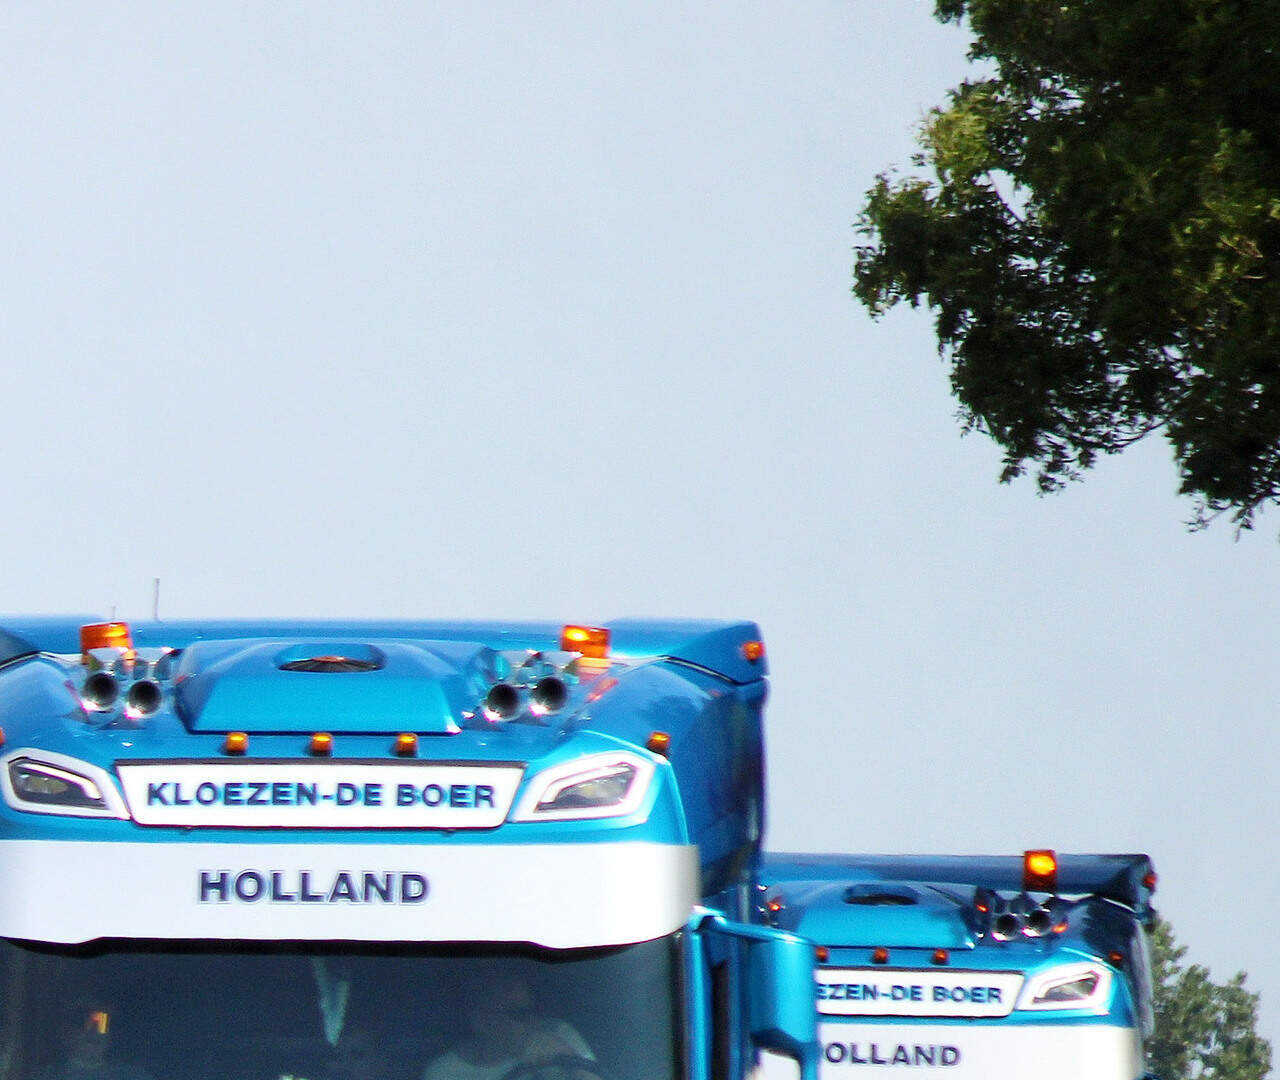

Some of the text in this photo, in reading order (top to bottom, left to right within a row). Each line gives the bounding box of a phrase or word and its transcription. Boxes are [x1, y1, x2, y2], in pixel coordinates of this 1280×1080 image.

[146, 781, 496, 809] KLOEZEN-DE BOER
[199, 869, 430, 905] HOLLAND
[816, 983, 1002, 1004] EZEN-DE BOER
[825, 1042, 961, 1067] OLLAND
